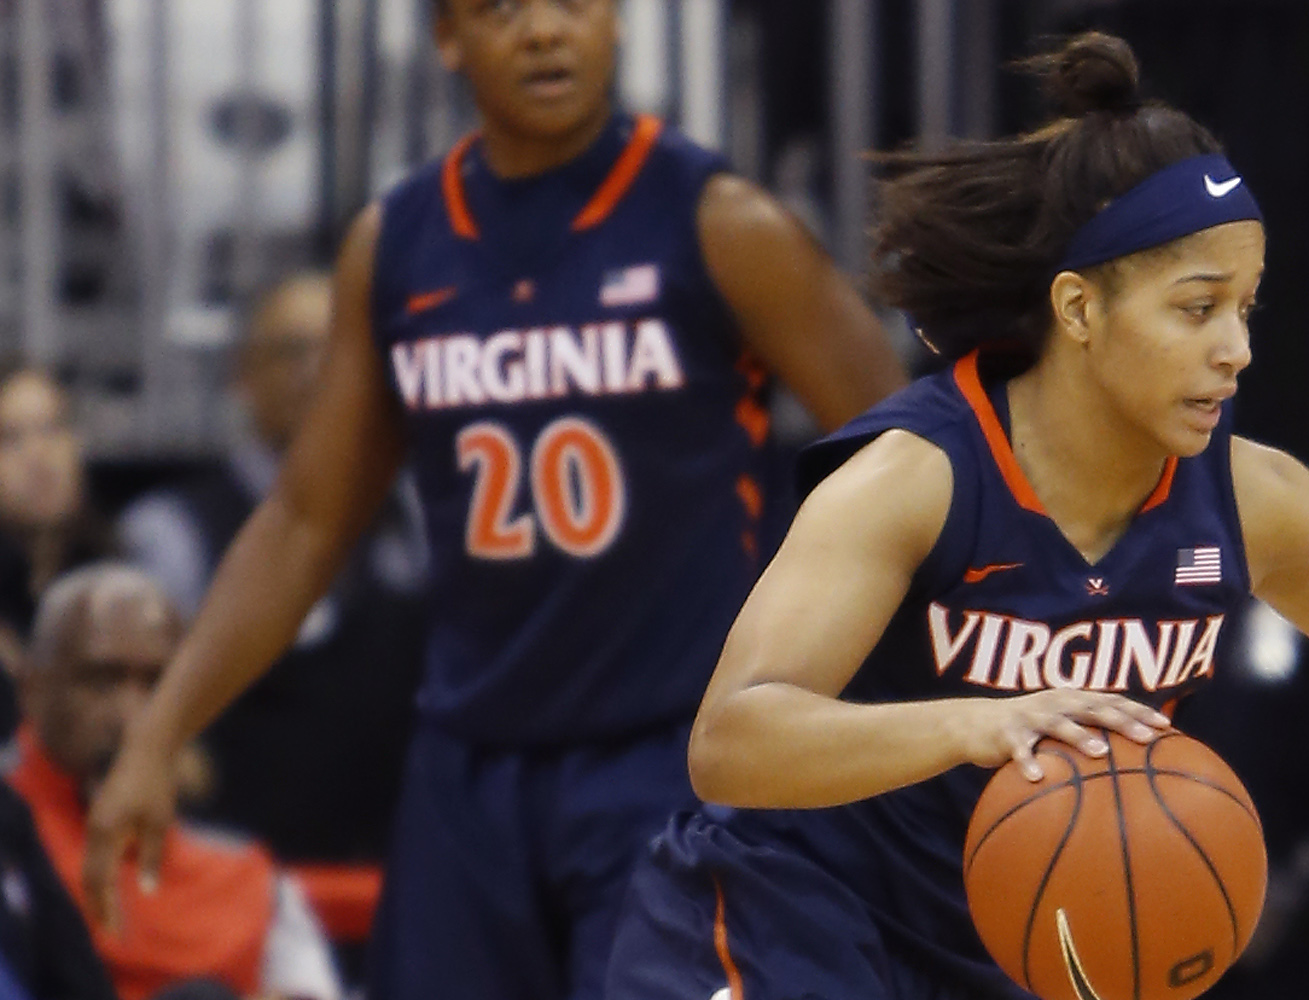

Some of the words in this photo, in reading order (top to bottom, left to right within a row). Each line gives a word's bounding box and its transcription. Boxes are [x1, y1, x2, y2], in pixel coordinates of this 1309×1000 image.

[391, 317, 687, 411] VIRGINIA
[455, 418, 625, 560] 20
[927, 601, 1225, 693] VIRGINIA
